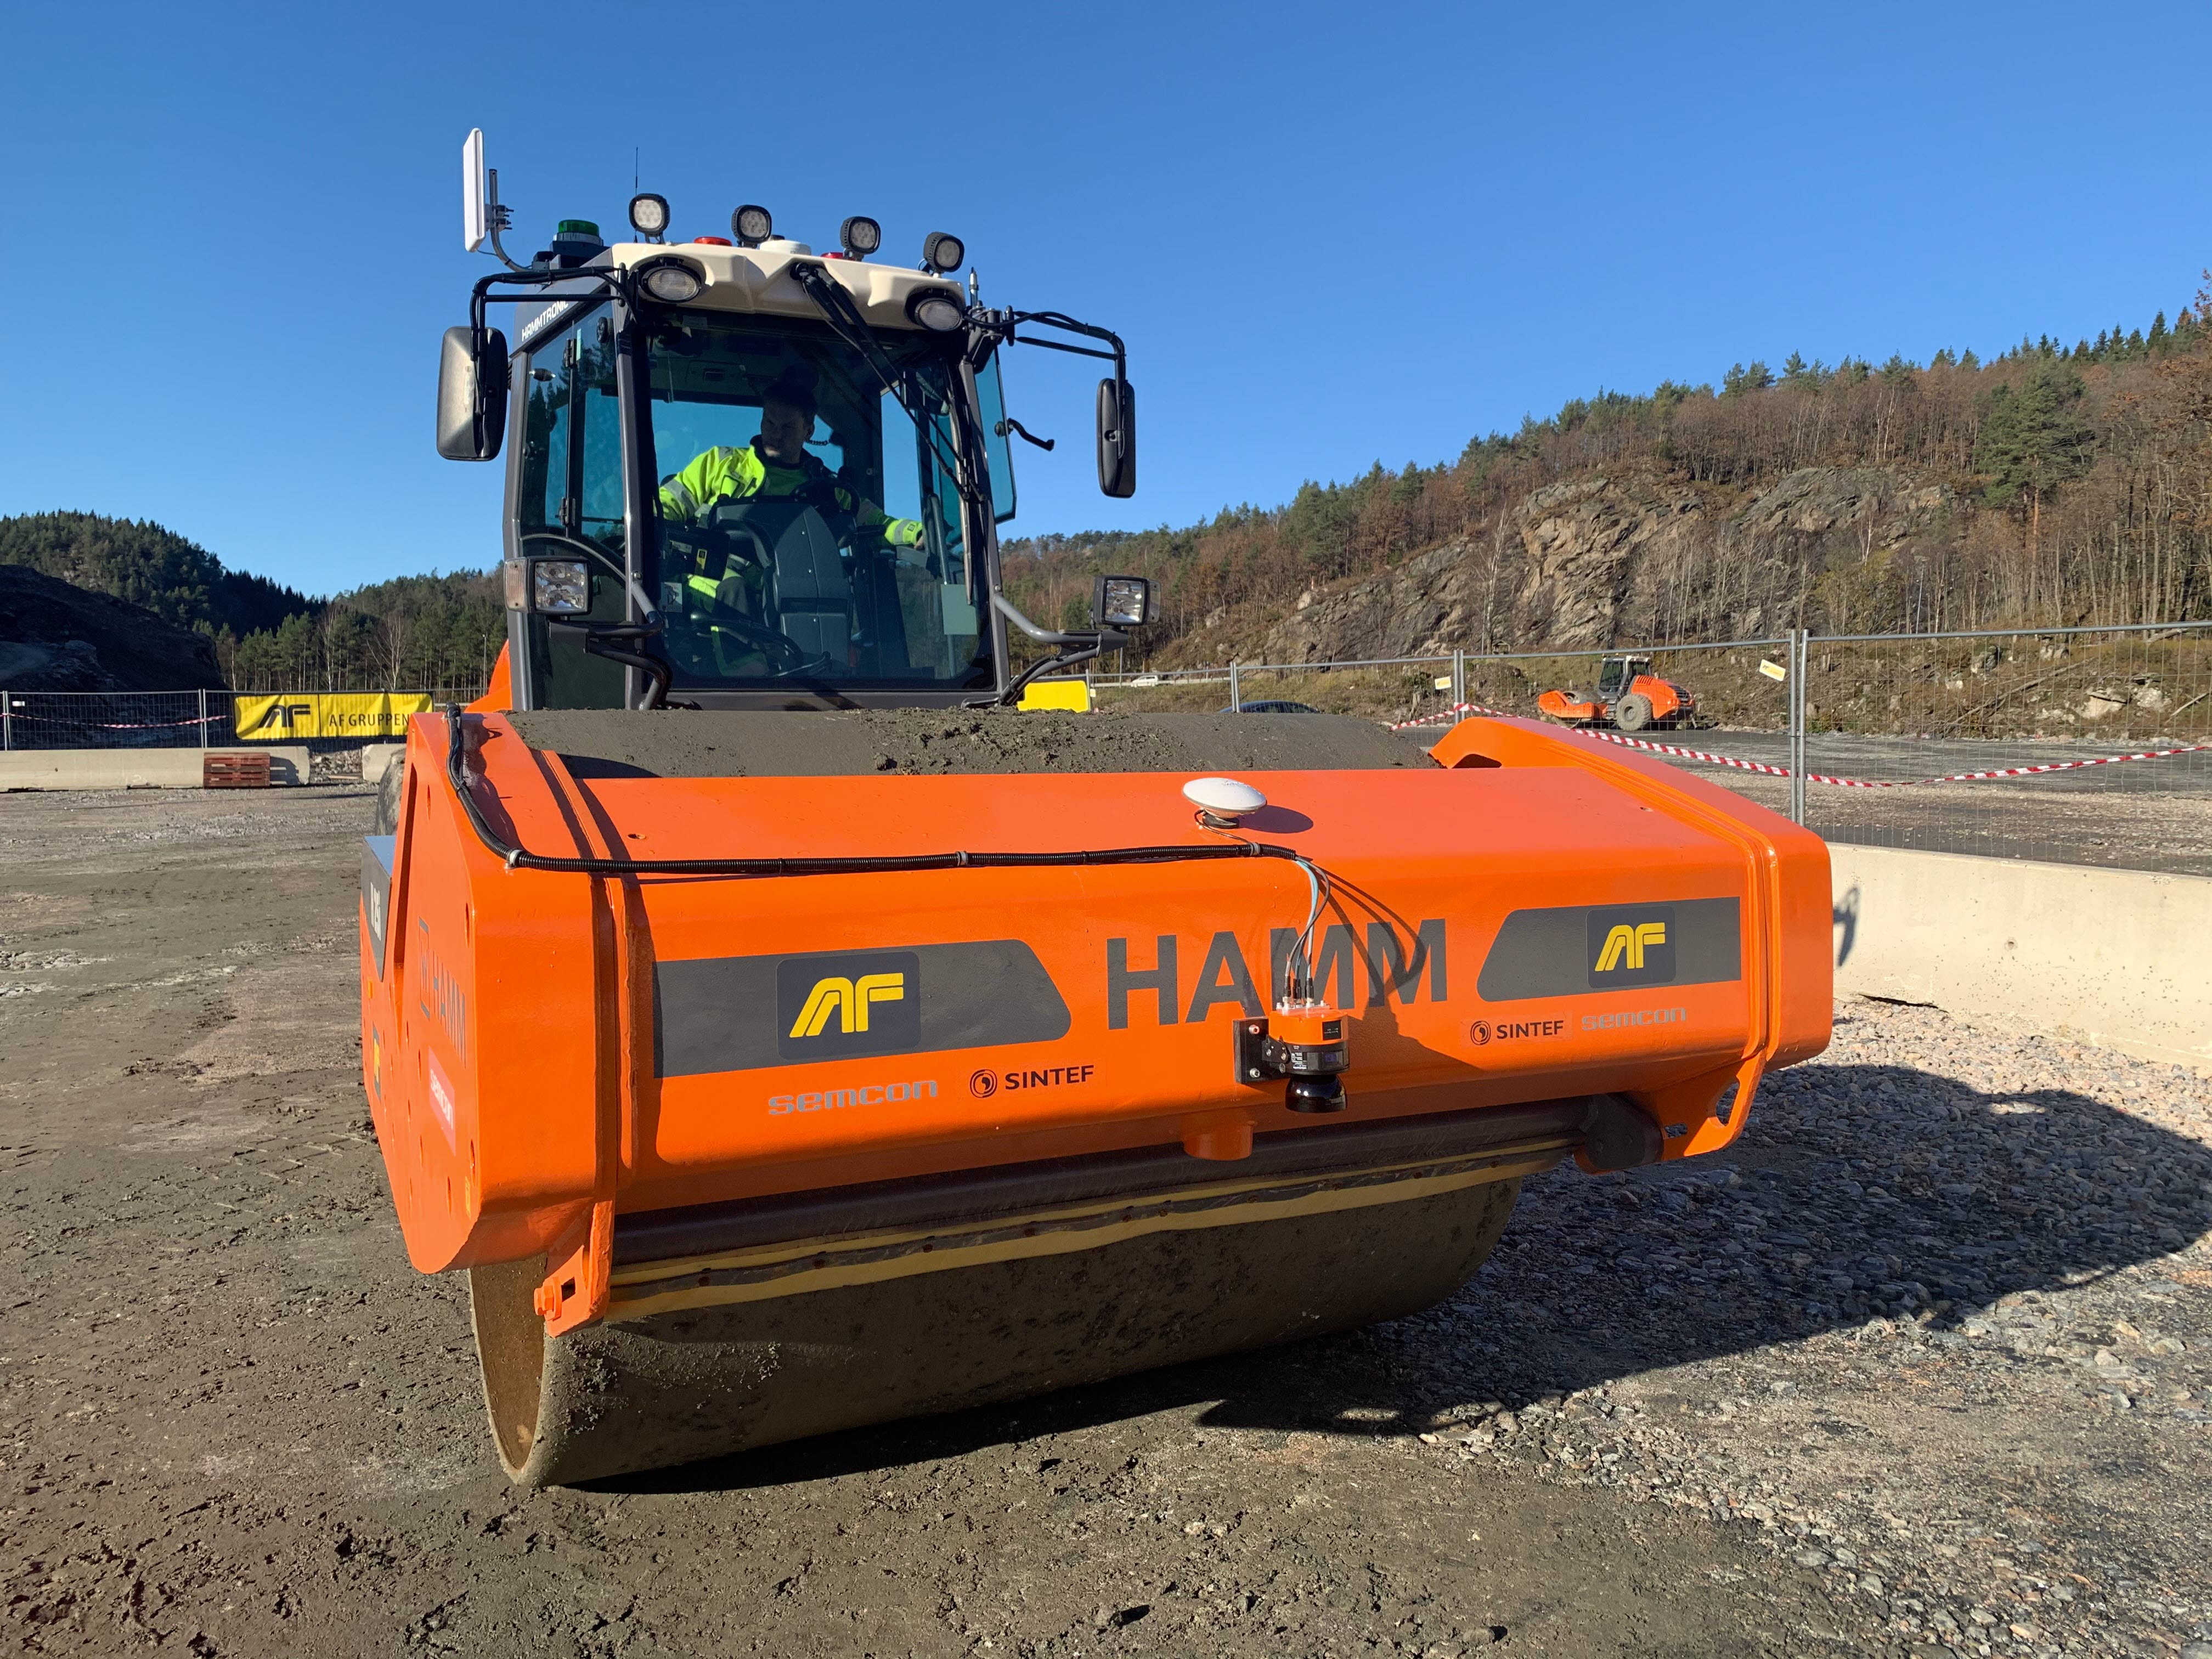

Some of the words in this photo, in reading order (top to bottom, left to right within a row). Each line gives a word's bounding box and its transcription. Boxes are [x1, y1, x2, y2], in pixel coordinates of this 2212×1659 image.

[257, 704, 311, 729] AF
[329, 714, 345, 727] AF
[348, 713, 410, 726] GRUPPEN
[1594, 922, 1666, 972] AF
[1107, 918, 1448, 1030] HAMM
[432, 950, 466, 1069] HAMM
[789, 972, 904, 1038] AF
[1582, 1007, 1687, 1032] semcon
[1496, 1020, 1564, 1040] SINTEF
[1005, 1065, 1094, 1091] SINTEF
[768, 1080, 938, 1116] semcon
